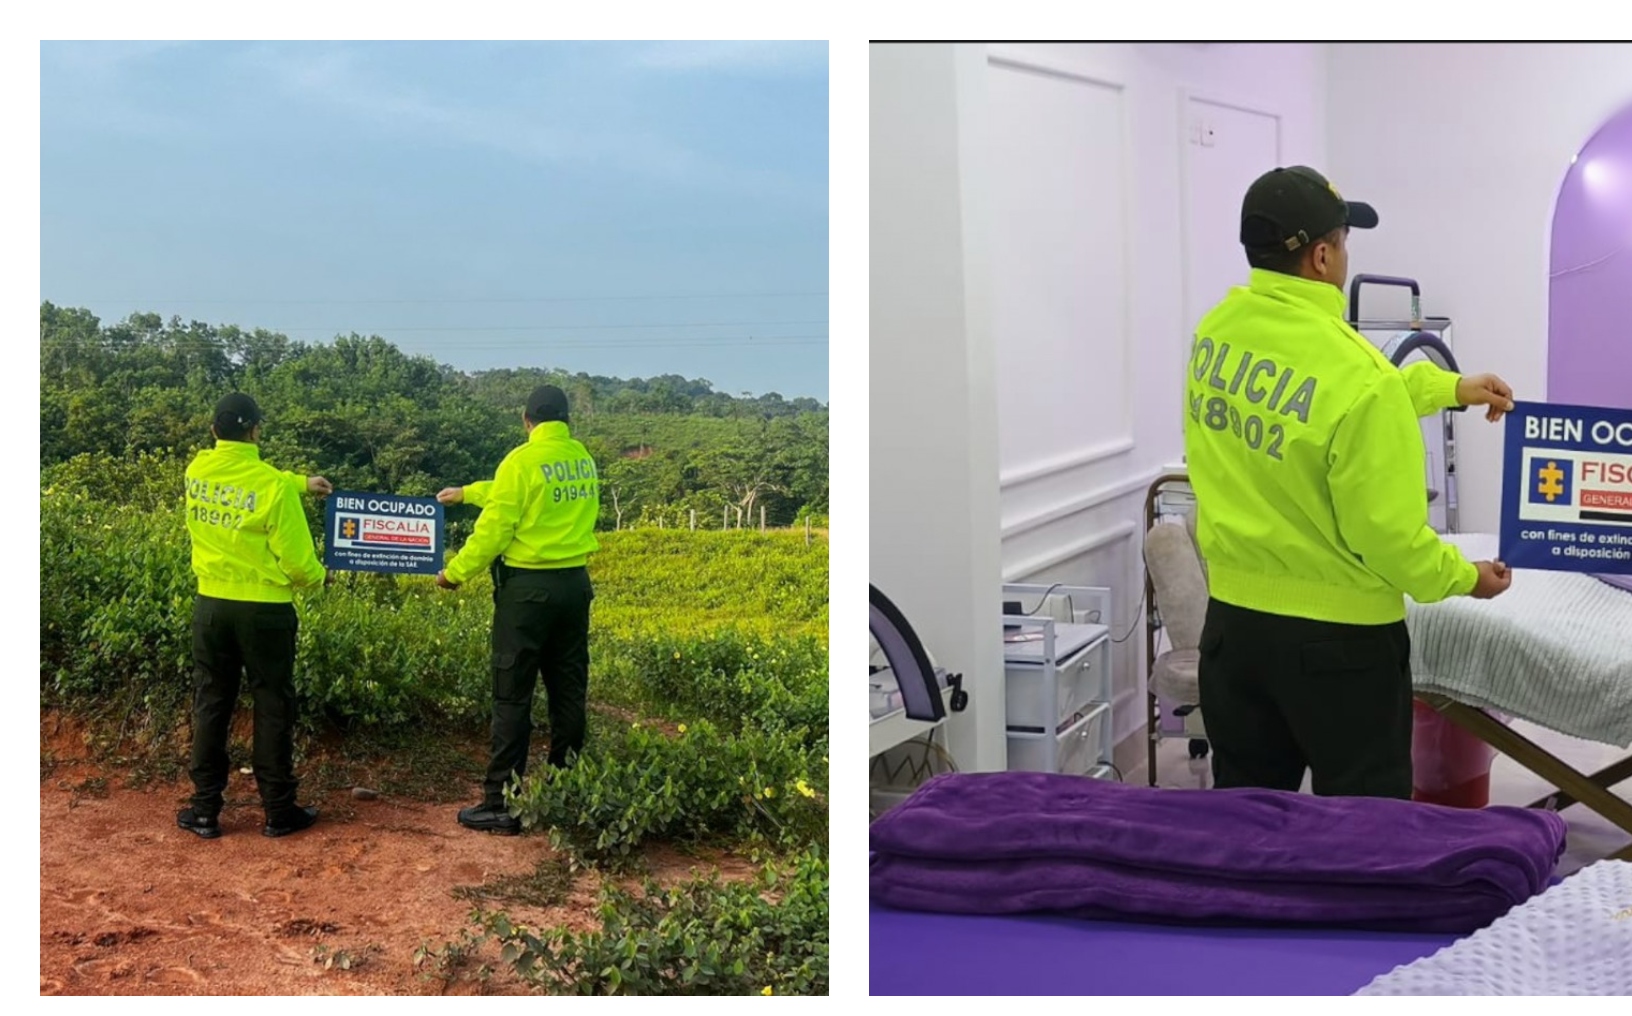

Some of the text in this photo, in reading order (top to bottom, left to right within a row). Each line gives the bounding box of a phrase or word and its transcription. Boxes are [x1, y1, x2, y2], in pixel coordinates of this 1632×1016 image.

[1190, 333, 1318, 424] OLICIA
[1524, 415, 1583, 443] BIEN
[336, 497, 436, 516] BIEN OCUPADO
[363, 518, 430, 533] FISCALÍA
[1521, 530, 1545, 541] con
[1547, 529, 1576, 542] fines
[1579, 532, 1596, 543] de
[1551, 546, 1561, 555] a
[1564, 545, 1630, 560] disposición
